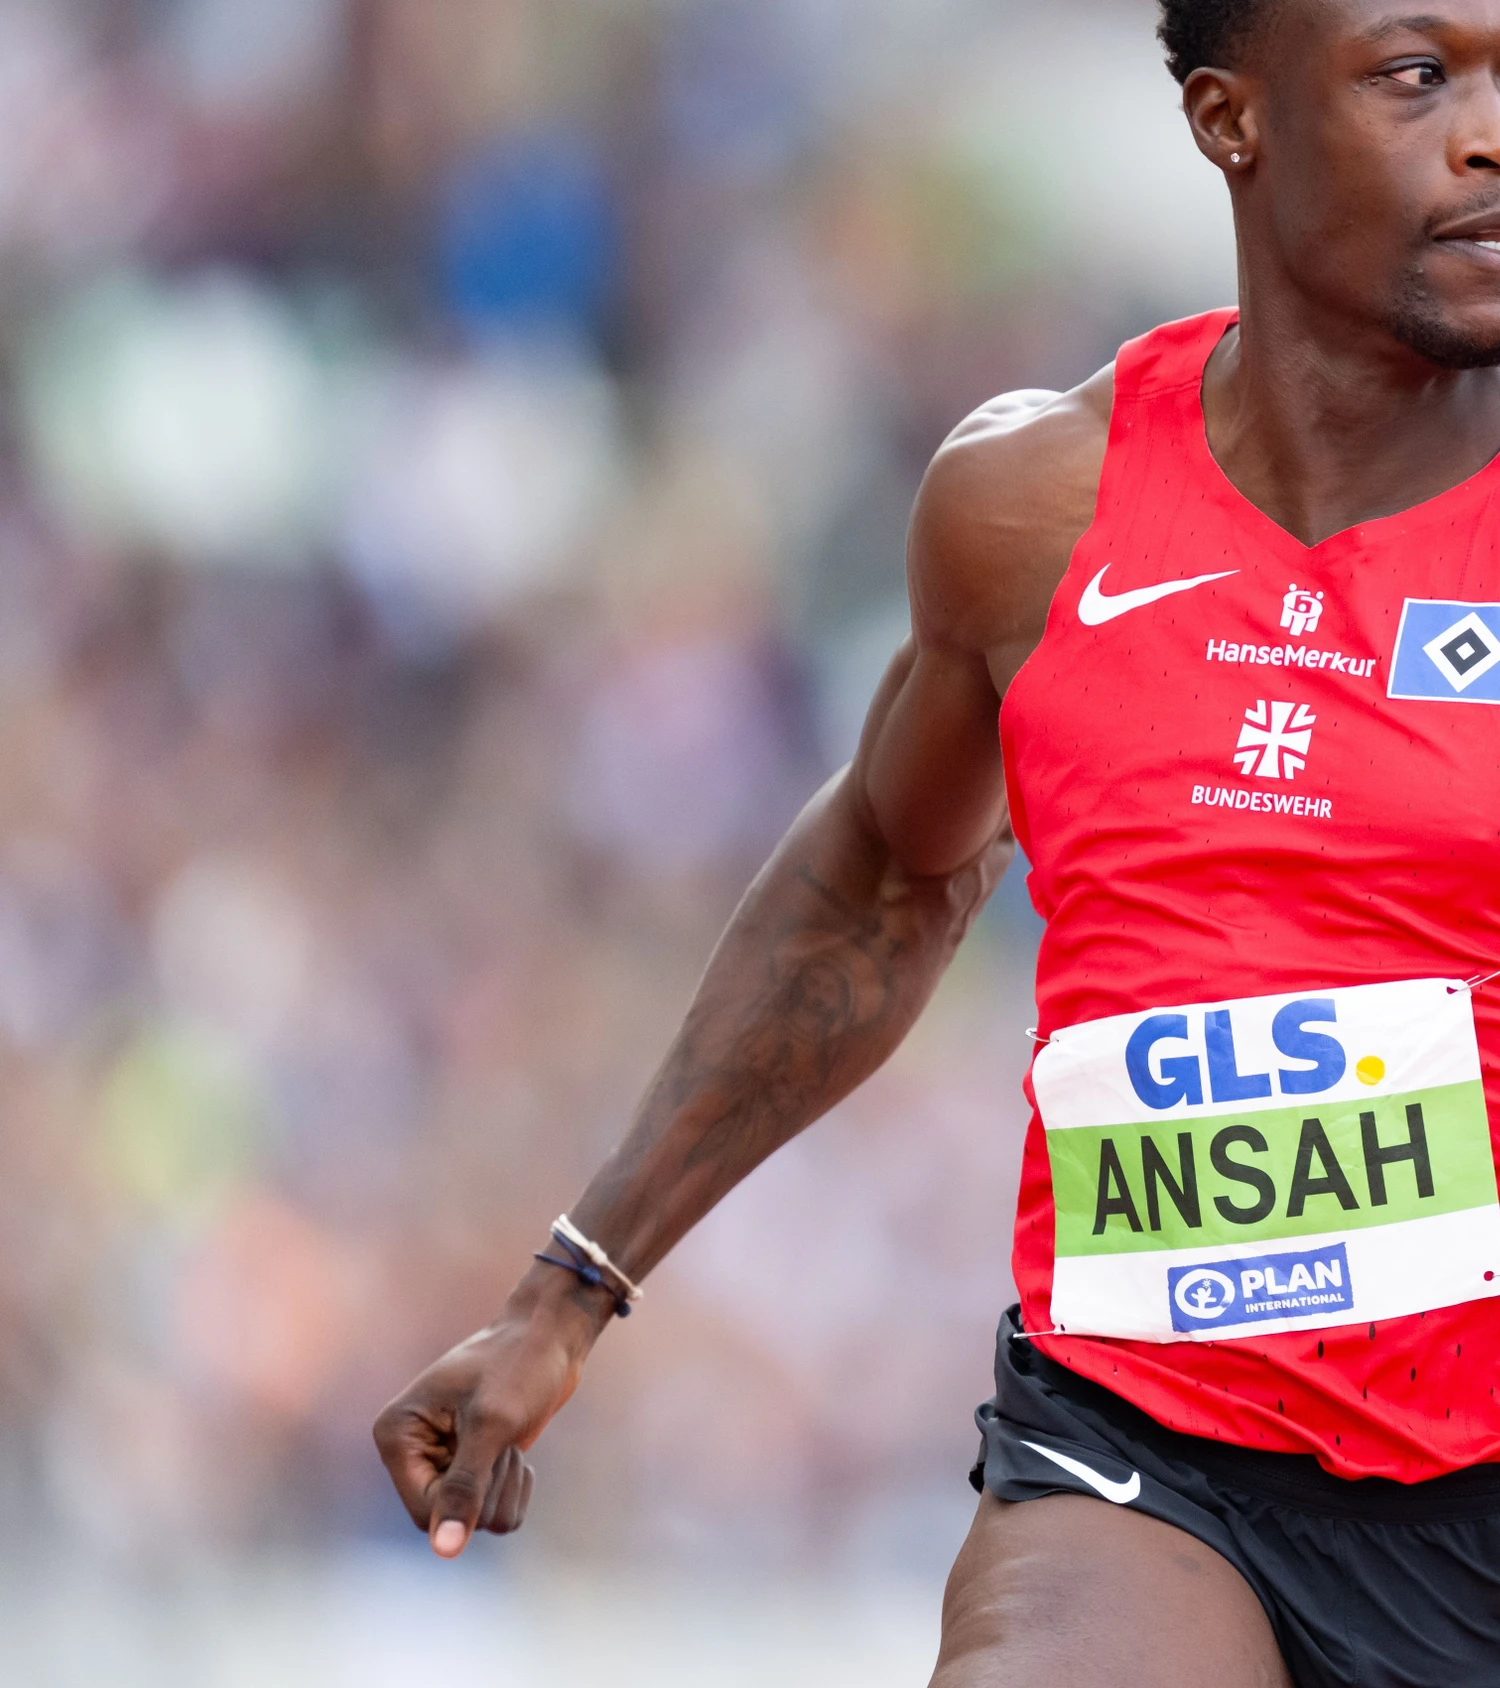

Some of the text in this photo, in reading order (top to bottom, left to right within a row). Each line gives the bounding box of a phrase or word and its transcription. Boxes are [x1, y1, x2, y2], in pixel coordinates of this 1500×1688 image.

[1206, 638, 1376, 678] HanseMerkur
[1191, 784, 1333, 819] BUNDESWEHR
[1092, 1102, 1435, 1235] ANSAH
[1240, 1258, 1343, 1299] PLAN
[1245, 1292, 1345, 1314] INTERNATIONAL
